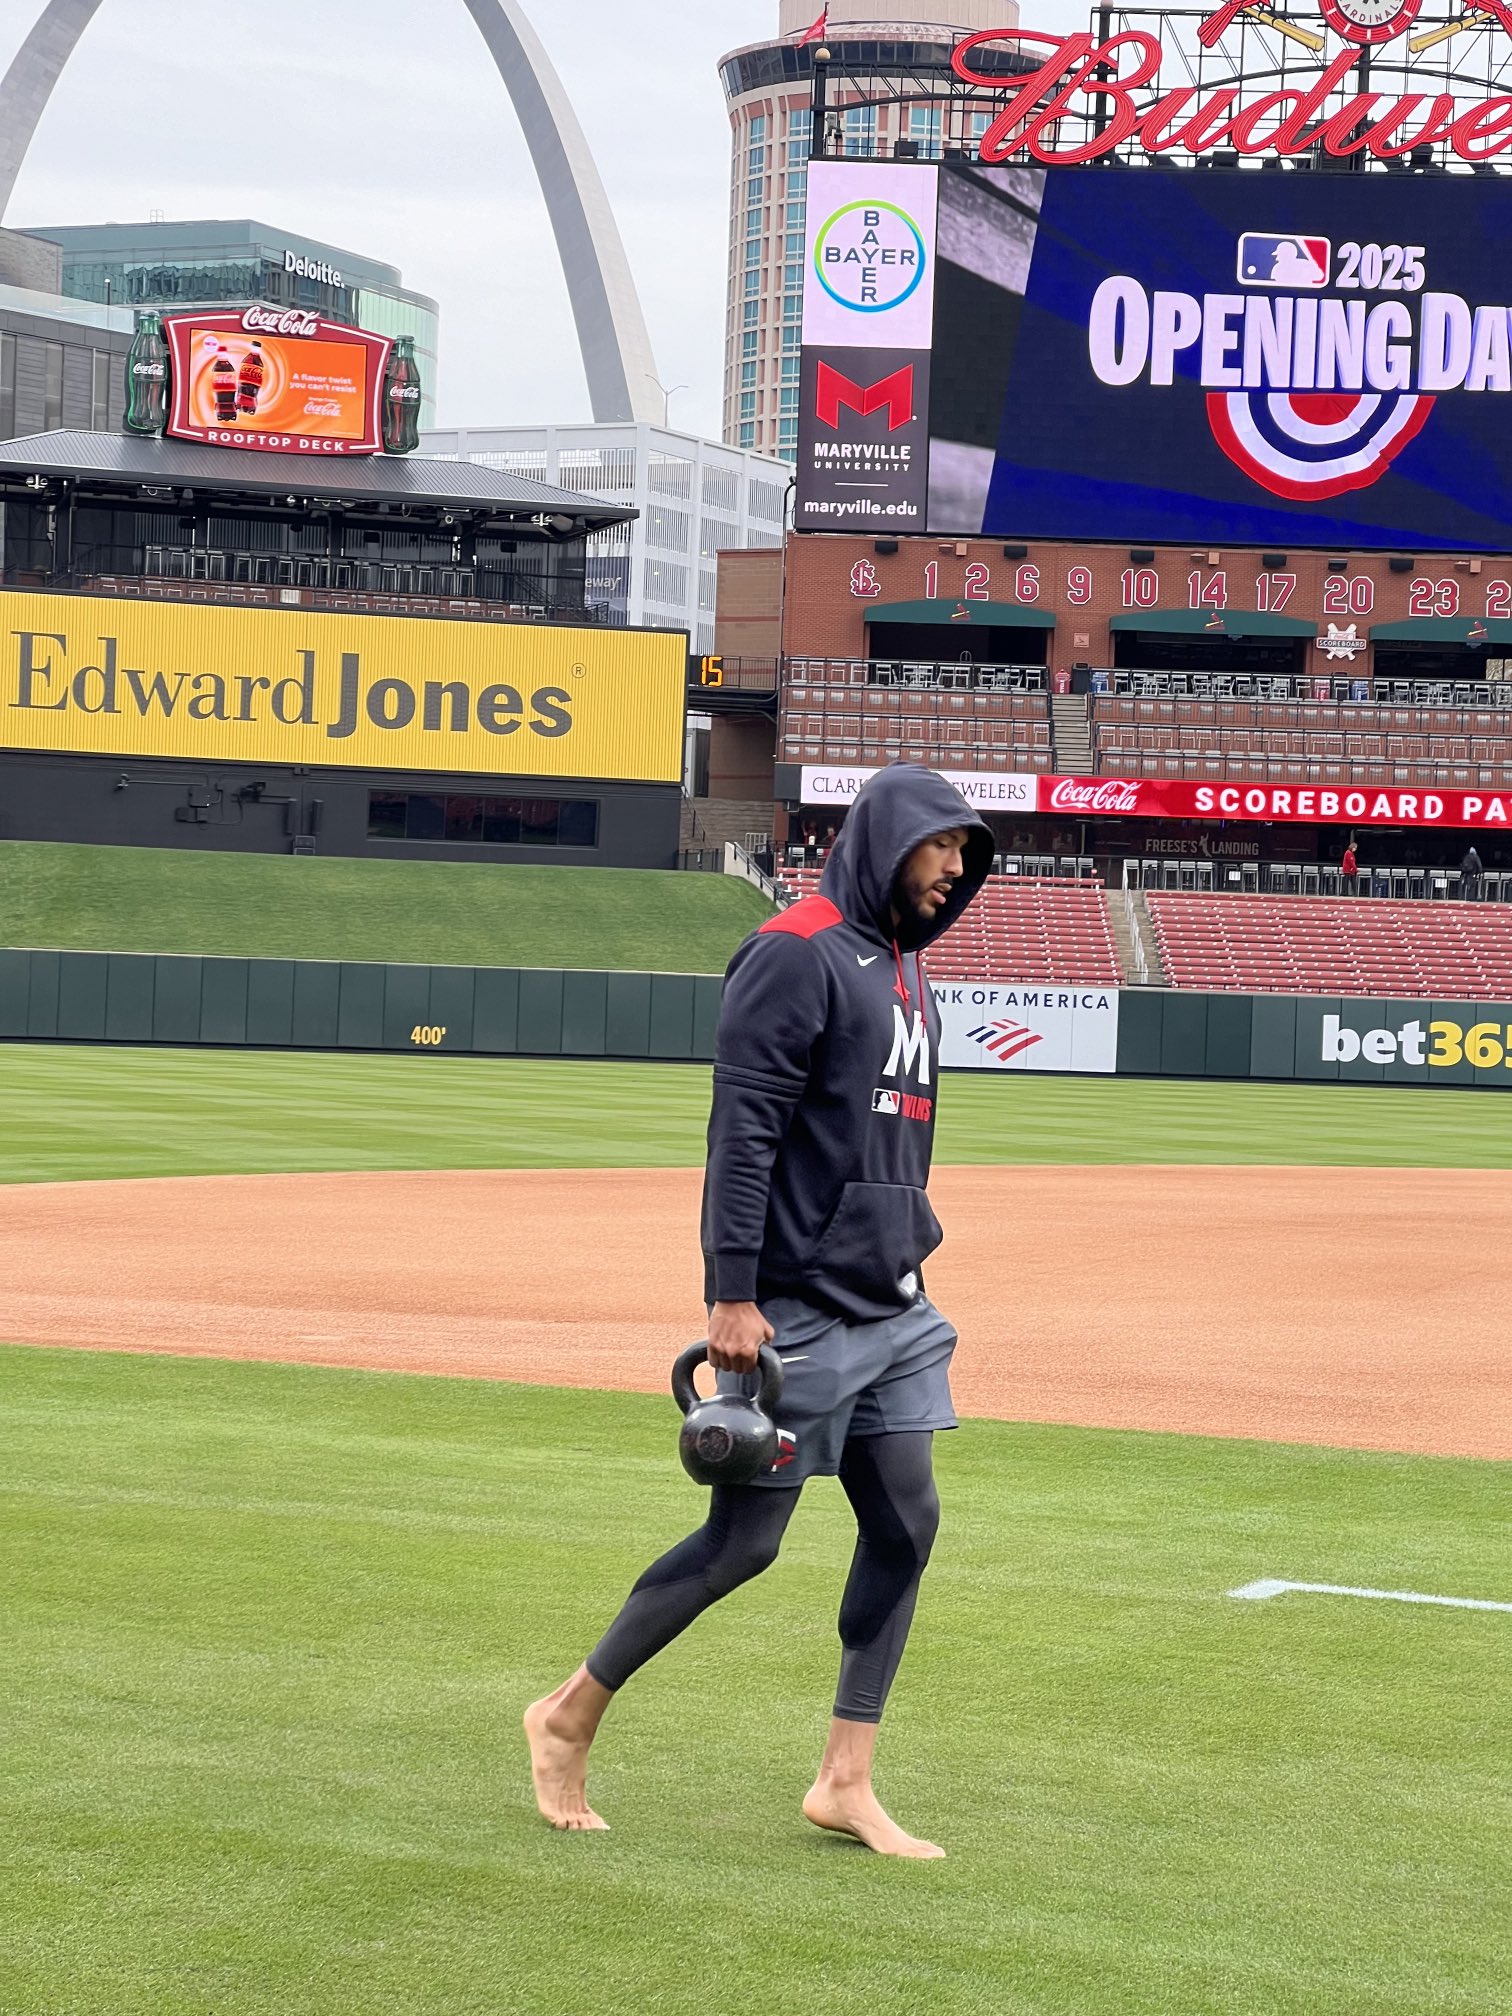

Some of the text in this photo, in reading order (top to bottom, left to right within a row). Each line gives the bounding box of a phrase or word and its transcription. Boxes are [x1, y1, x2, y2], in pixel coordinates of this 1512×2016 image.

[825, 246, 915, 265] BAYER
[1336, 242, 1425, 290] 2025
[242, 306, 321, 337] Coca-Cola
[1088, 275, 1512, 391] OPENING DA
[133, 362, 165, 376] Coca-Cola
[390, 385, 419, 398] Coca-Cola
[207, 431, 345, 452] ROOFTOP DECK
[814, 442, 911, 460] MARYVILLE
[814, 461, 909, 471] UNIVERSITY
[804, 499, 917, 517] maryville.edu
[925, 561, 938, 599] 1
[965, 562, 989, 601] 2
[1015, 564, 1040, 603] 6
[1067, 566, 1092, 605] 9
[1121, 568, 1158, 607] 10
[1188, 571, 1227, 609] 14
[1256, 573, 1297, 612] 17
[1324, 575, 1374, 614] 20
[1409, 578, 1460, 617] 23
[1486, 580, 1512, 619] 2
[1319, 640, 1365, 648] SCOREBOARD
[701, 656, 723, 687] 15
[9, 630, 573, 739] Edward Jones
[1051, 778, 1512, 822] Coca-Cola SCOREBOARD PA
[1146, 838, 1260, 856] FREESE'S LANDING
[971, 990, 1000, 1006] OF
[1005, 992, 1110, 1010] AMERICA
[411, 1026, 446, 1045] 400'
[882, 1004, 930, 1085] M
[1322, 1014, 1512, 1069] bet36
